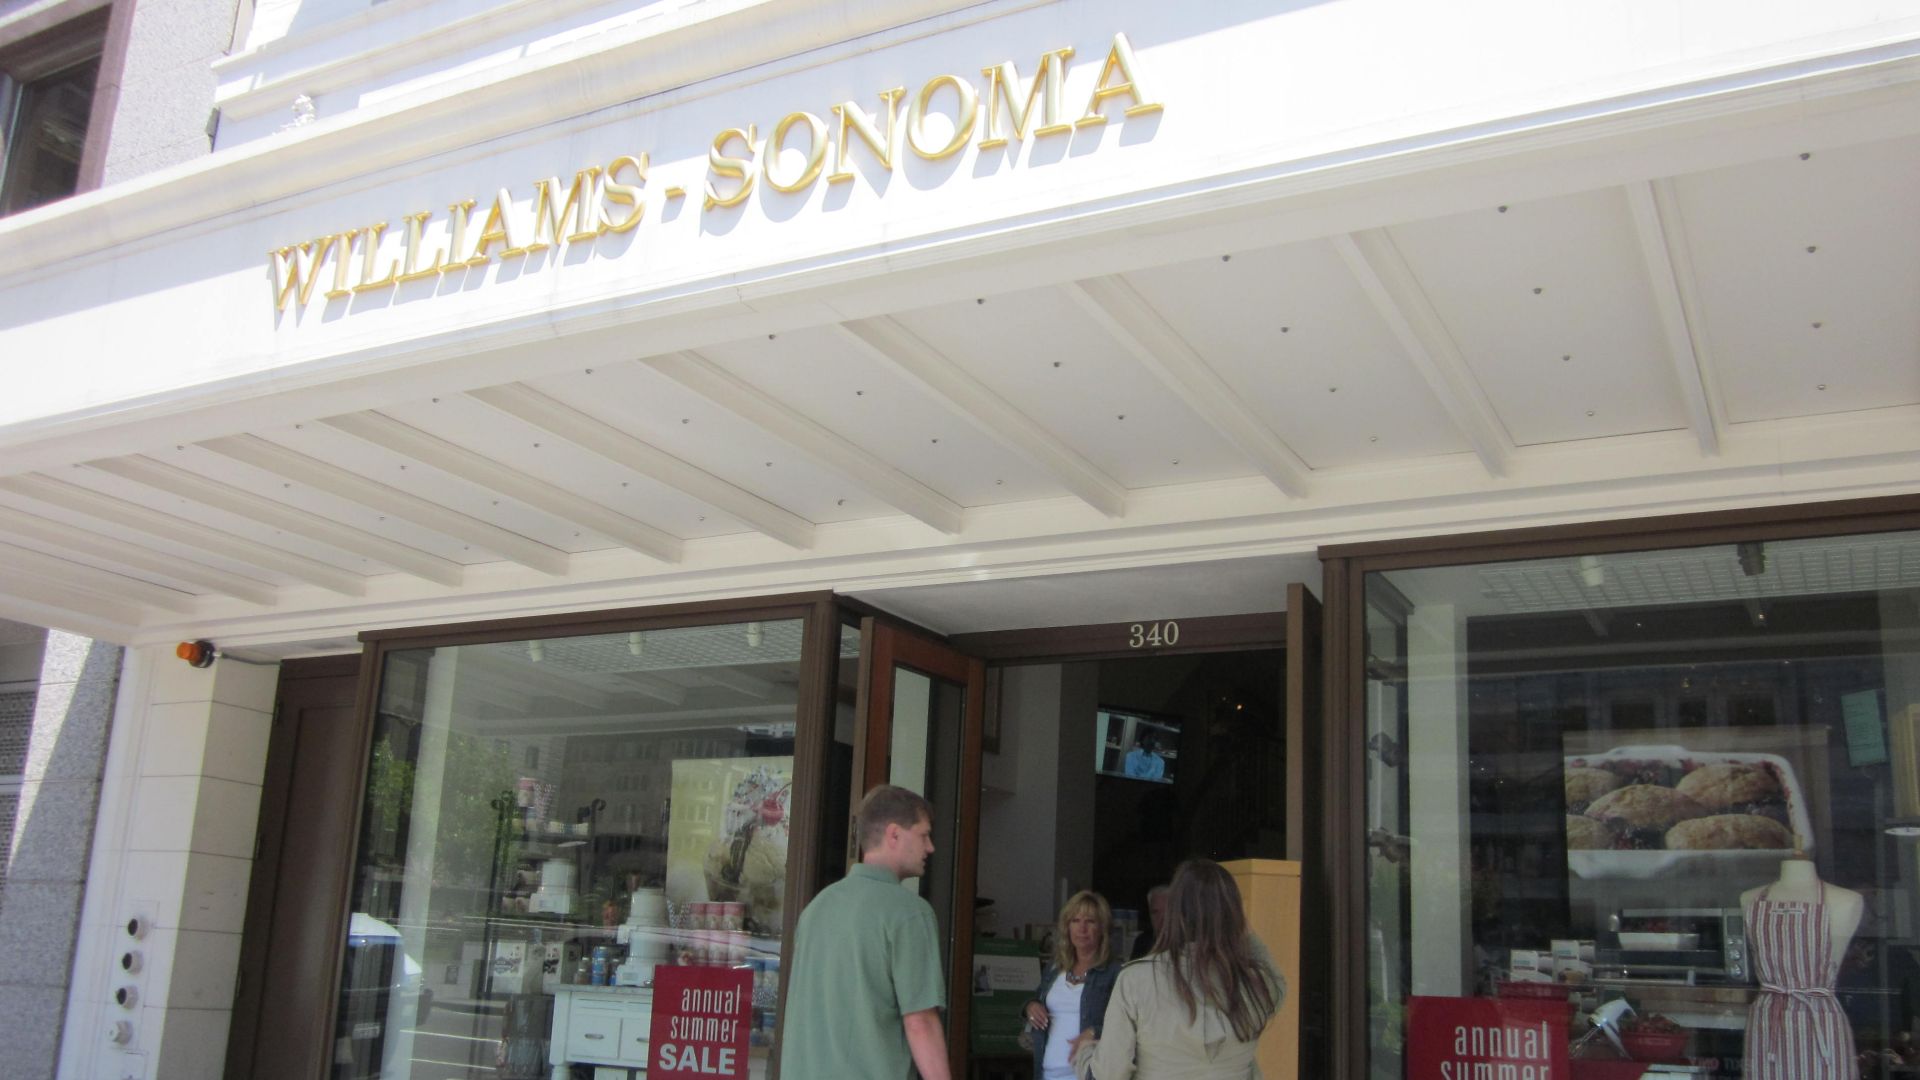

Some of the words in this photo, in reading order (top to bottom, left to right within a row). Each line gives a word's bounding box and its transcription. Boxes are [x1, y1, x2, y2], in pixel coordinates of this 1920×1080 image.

[1129, 621, 1179, 648] 340
[681, 984, 741, 1015] annual
[670, 1016, 739, 1043] summer
[1454, 1020, 1549, 1060] annual
[658, 1043, 736, 1076] SALE
